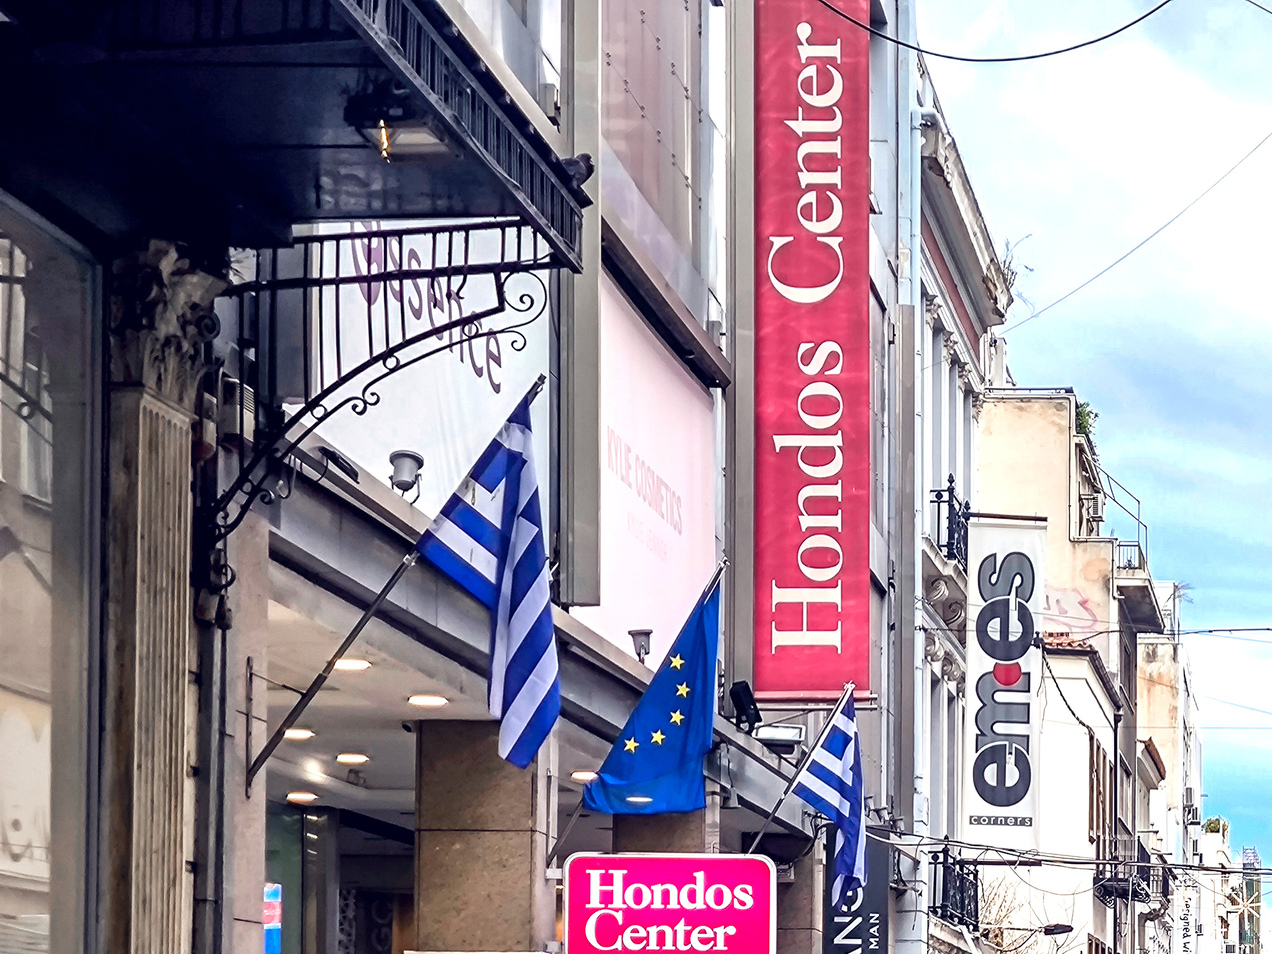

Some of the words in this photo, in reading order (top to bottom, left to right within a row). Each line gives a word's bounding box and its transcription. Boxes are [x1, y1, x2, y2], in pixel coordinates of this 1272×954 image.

[768, 21, 844, 304] Center
[635, 454, 682, 536] COSMETICS
[770, 340, 843, 655] Hondos
[970, 816, 1033, 827] corners
[585, 869, 754, 911] Hondos
[585, 910, 737, 952] Center
[868, 913, 880, 950] MAN
